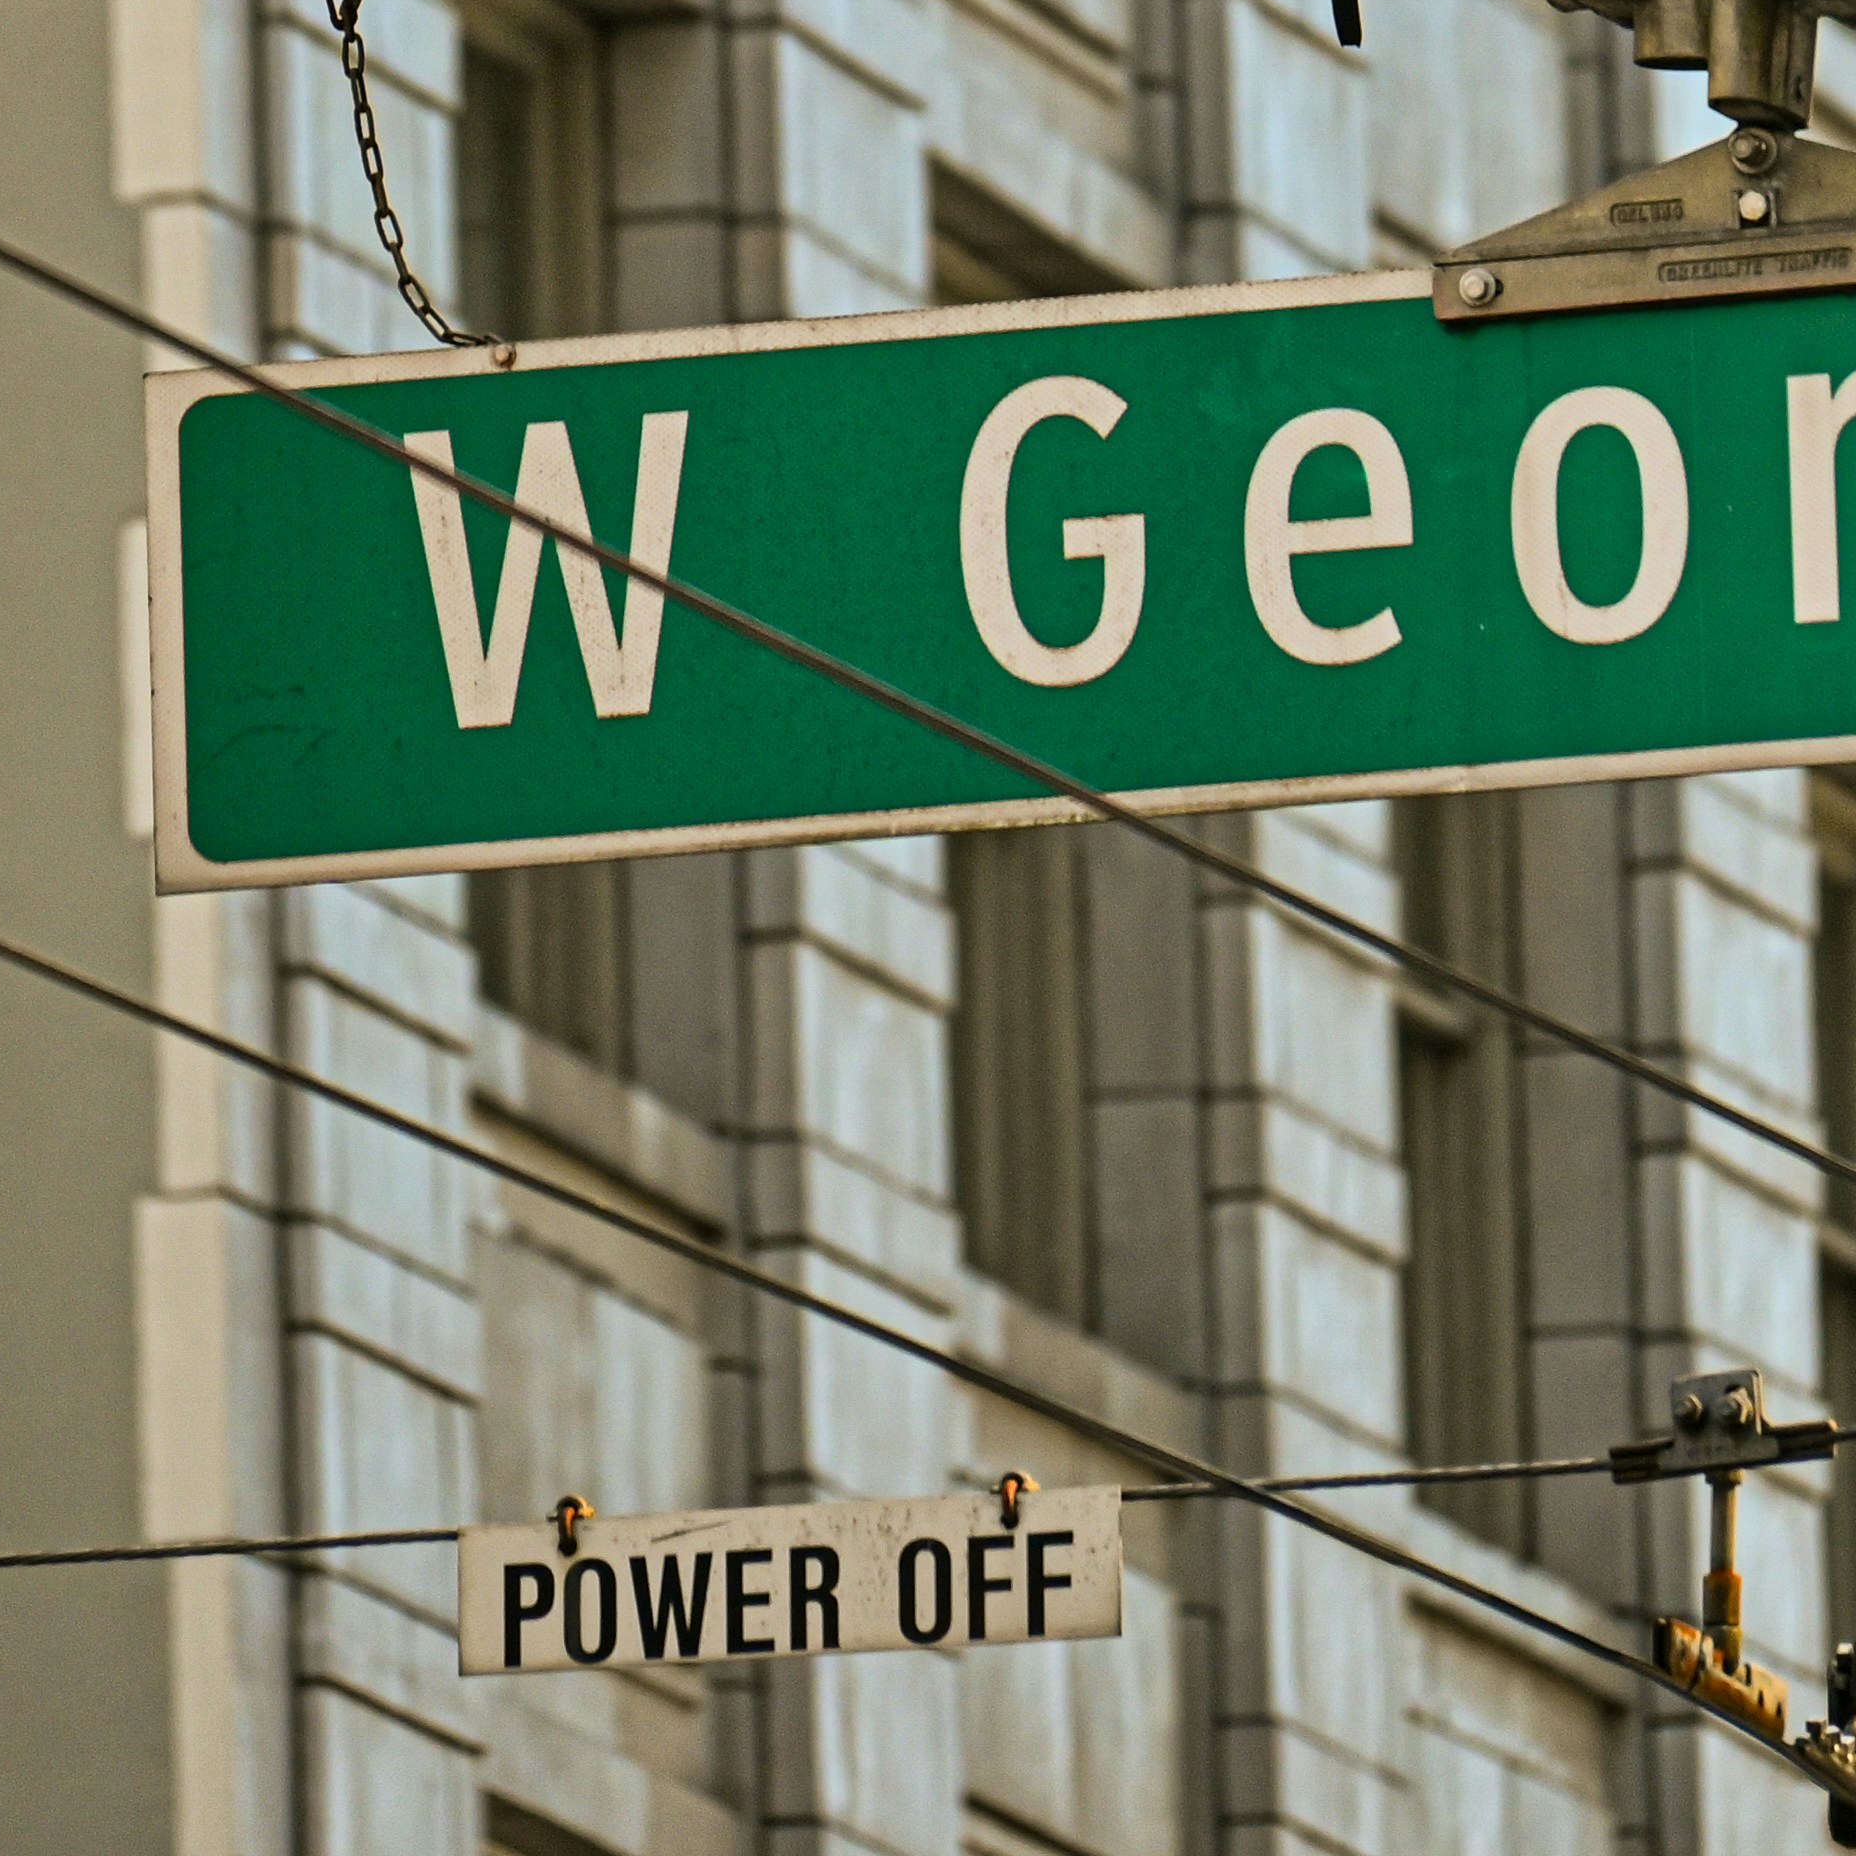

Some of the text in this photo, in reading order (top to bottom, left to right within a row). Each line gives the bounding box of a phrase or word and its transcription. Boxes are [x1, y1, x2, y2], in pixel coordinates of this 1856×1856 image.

[402, 409, 690, 730] W
[503, 1529, 1075, 1670] POWER OFF
